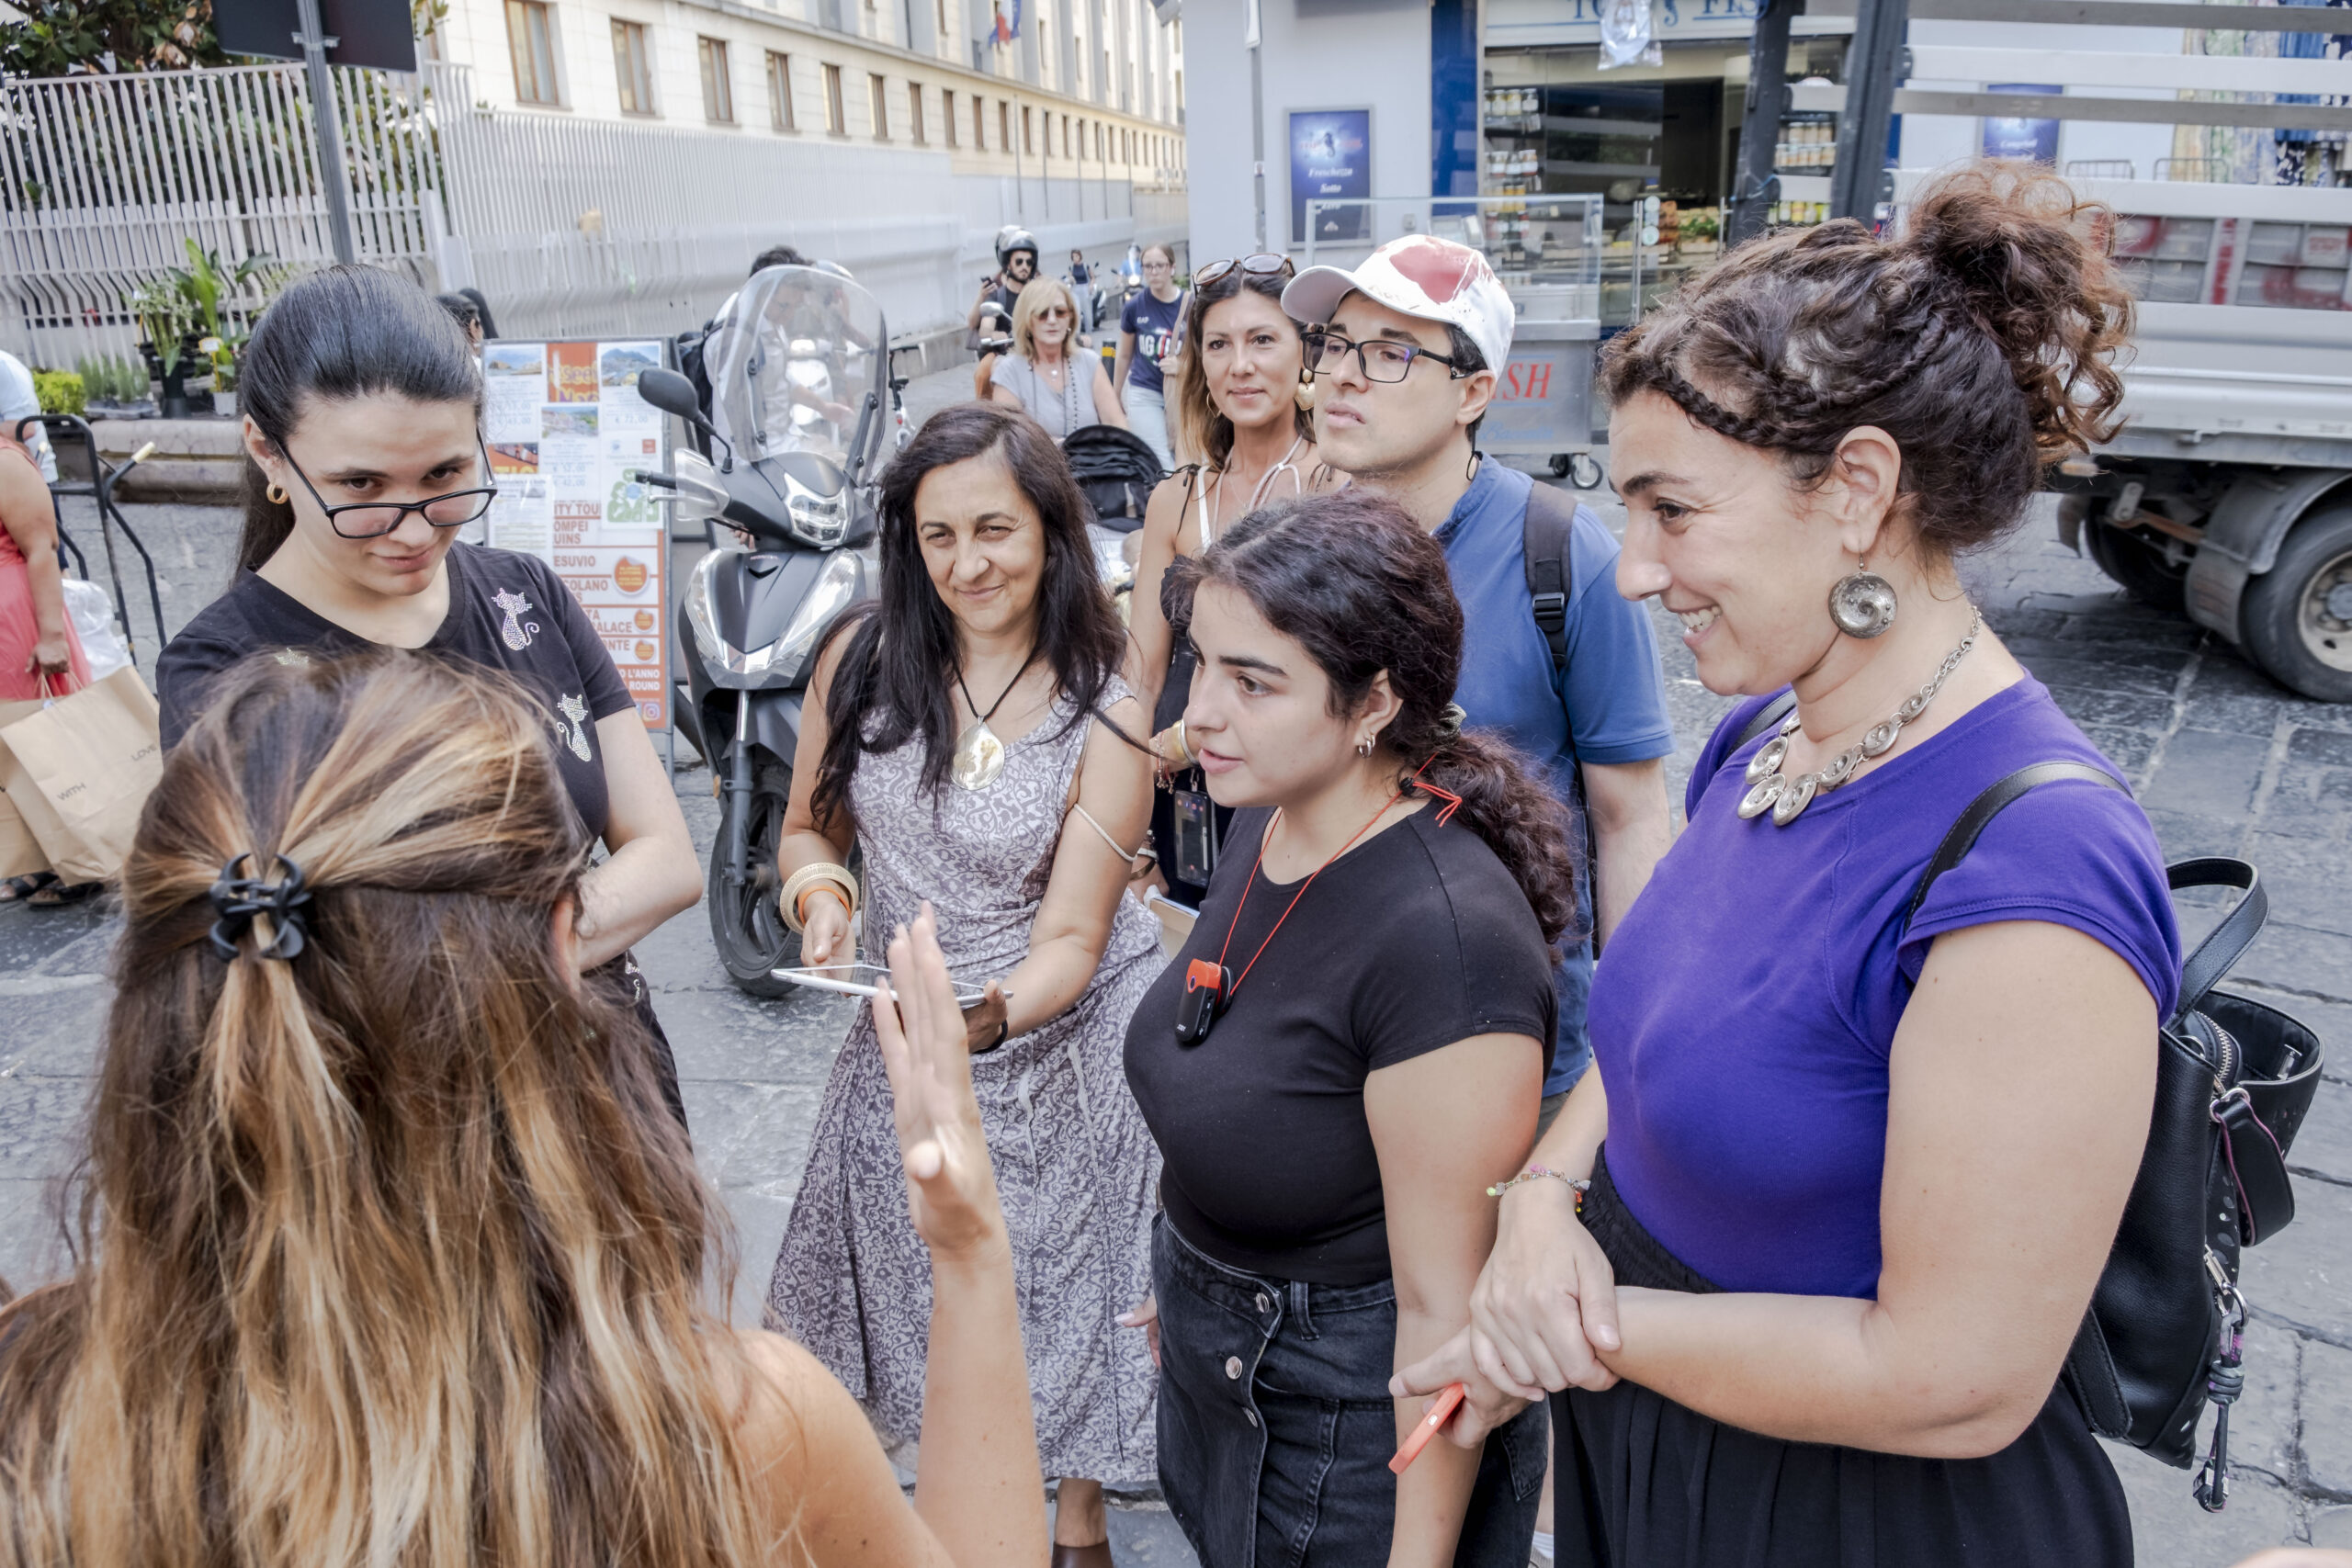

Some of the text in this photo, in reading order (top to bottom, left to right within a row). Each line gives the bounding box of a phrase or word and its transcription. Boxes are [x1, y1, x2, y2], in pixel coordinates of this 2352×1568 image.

[1492, 362, 1554, 400] SH
[628, 669, 661, 679] L'ANNO
[628, 681, 661, 691] ROUND
[56, 743, 158, 801] WITH LOVE
